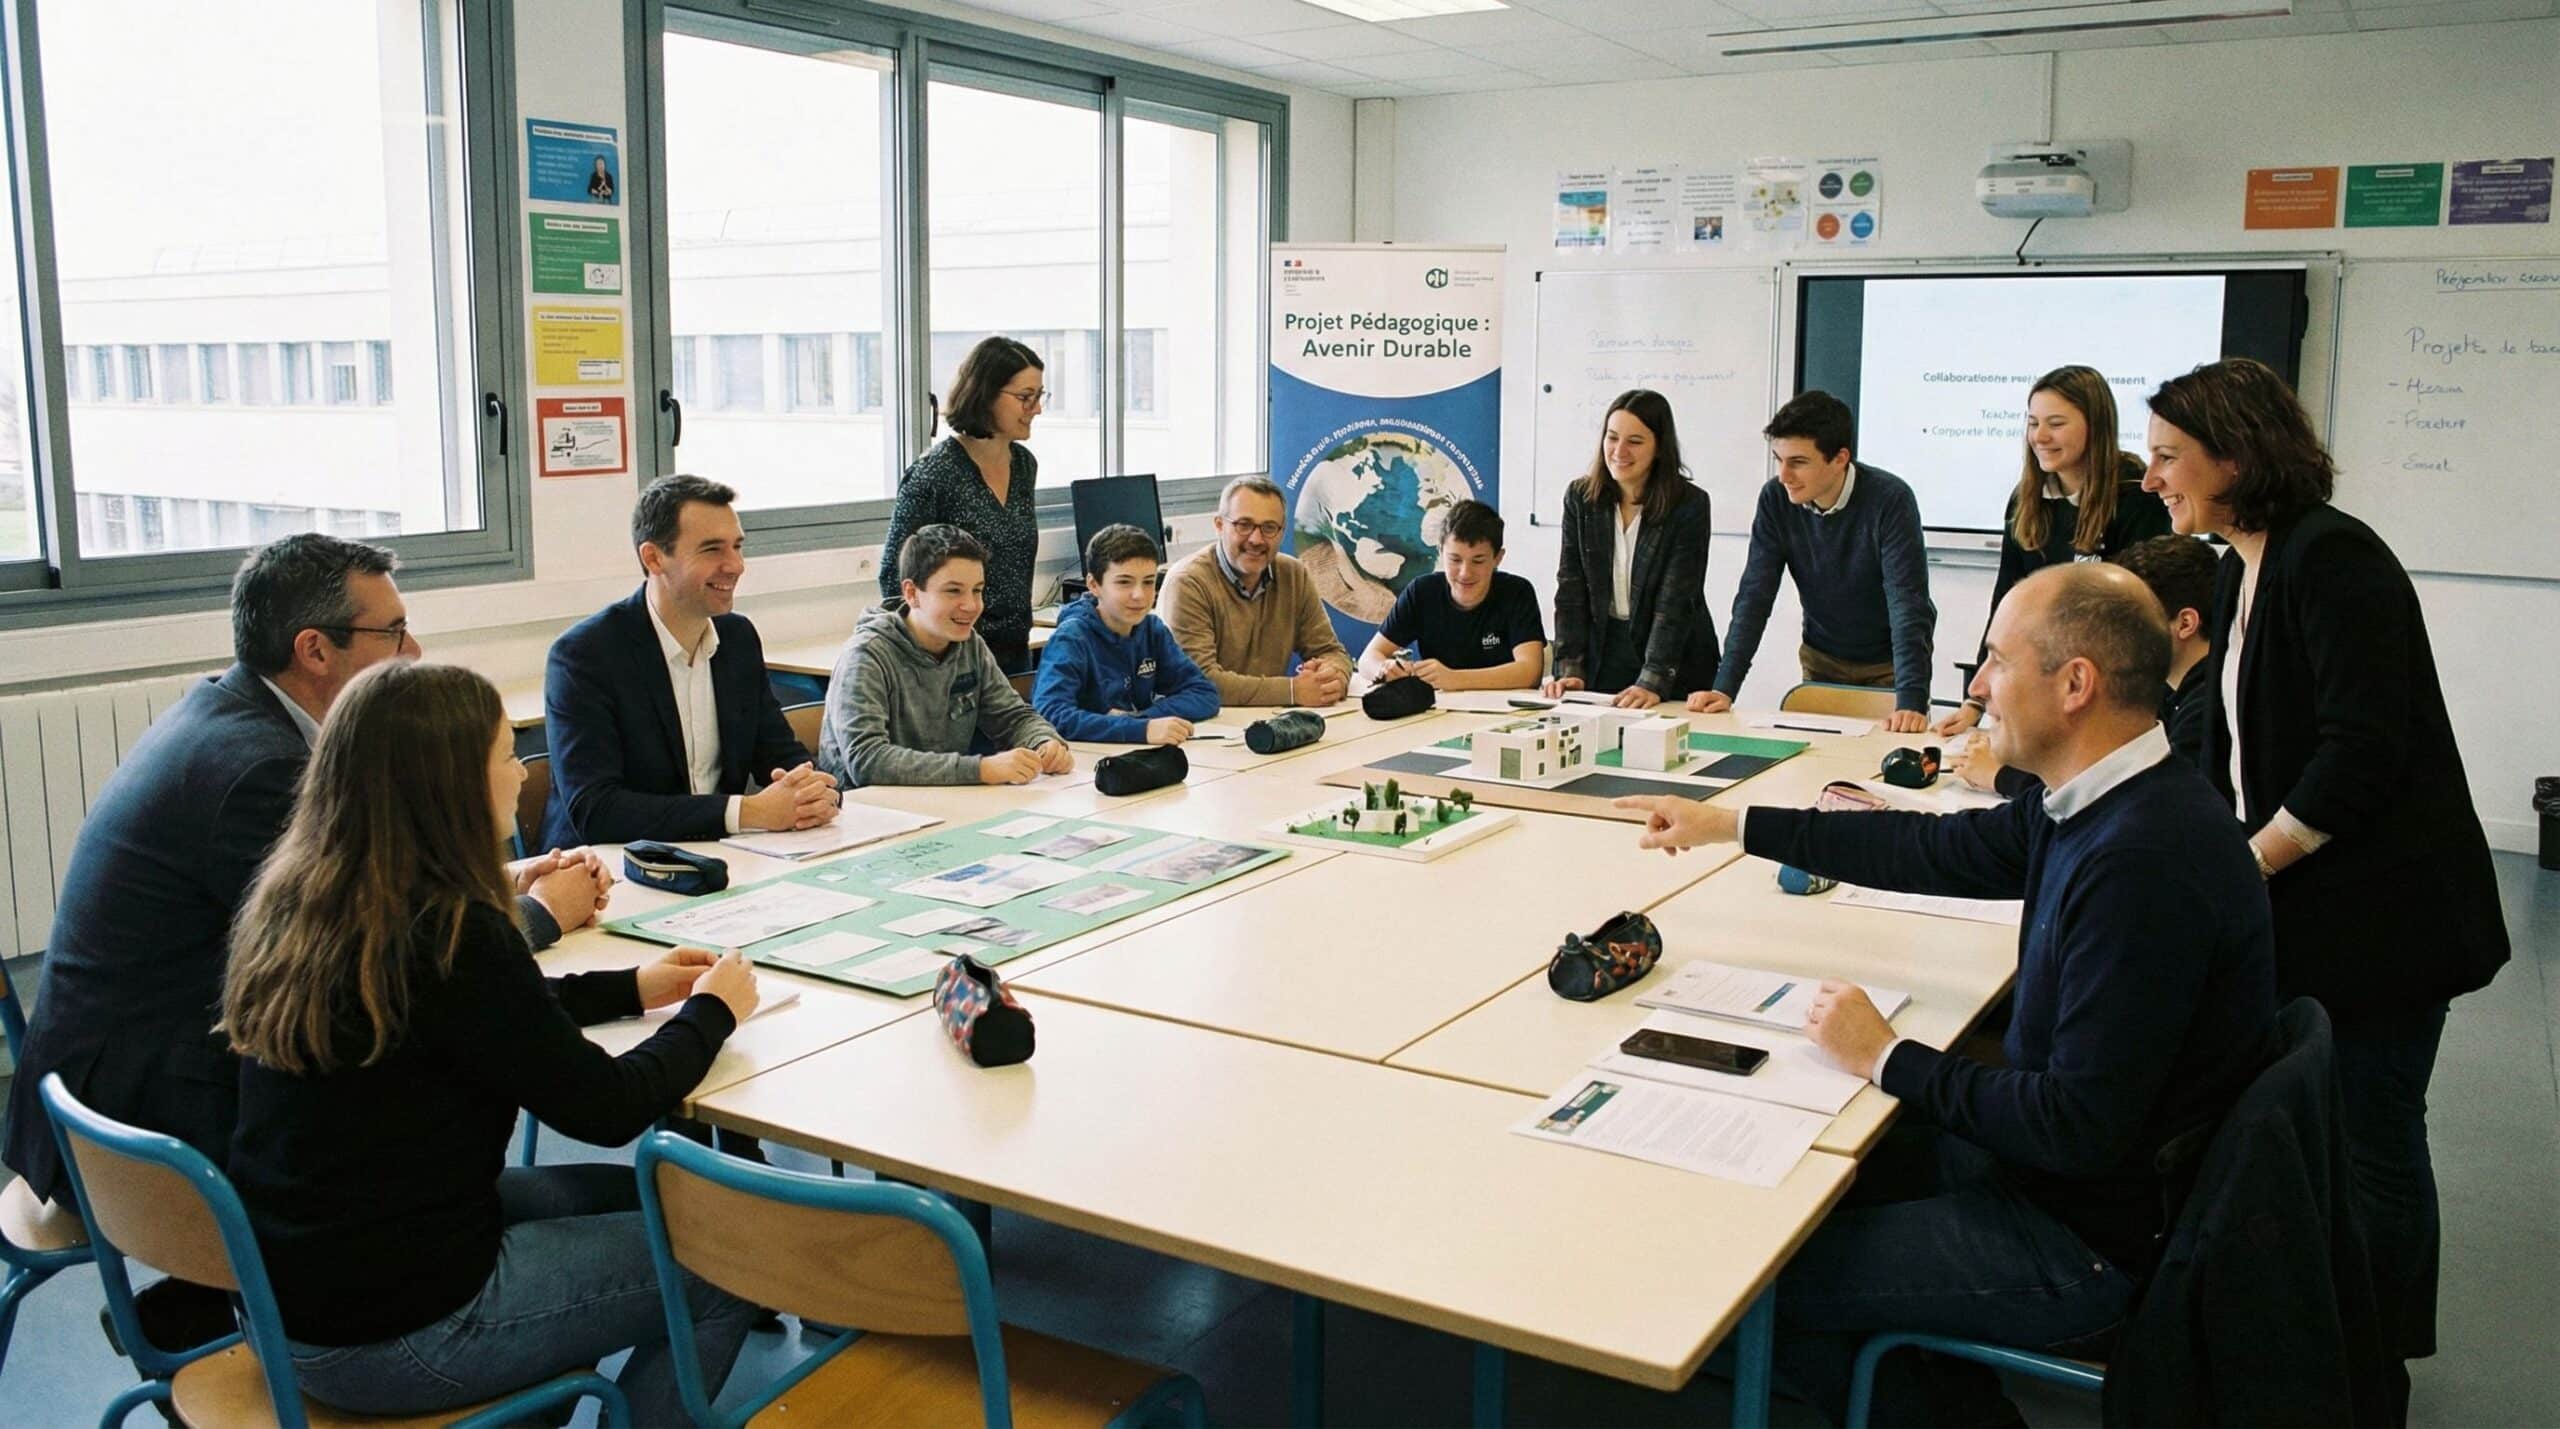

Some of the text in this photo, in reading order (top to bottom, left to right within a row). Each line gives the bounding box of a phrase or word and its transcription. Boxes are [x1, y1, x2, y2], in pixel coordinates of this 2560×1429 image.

[1285, 312, 1343, 335] Projet
[1350, 312, 1479, 336] Pédagogique
[1302, 338, 1472, 358] Avenir Durable
[2403, 326, 2488, 365] Projets
